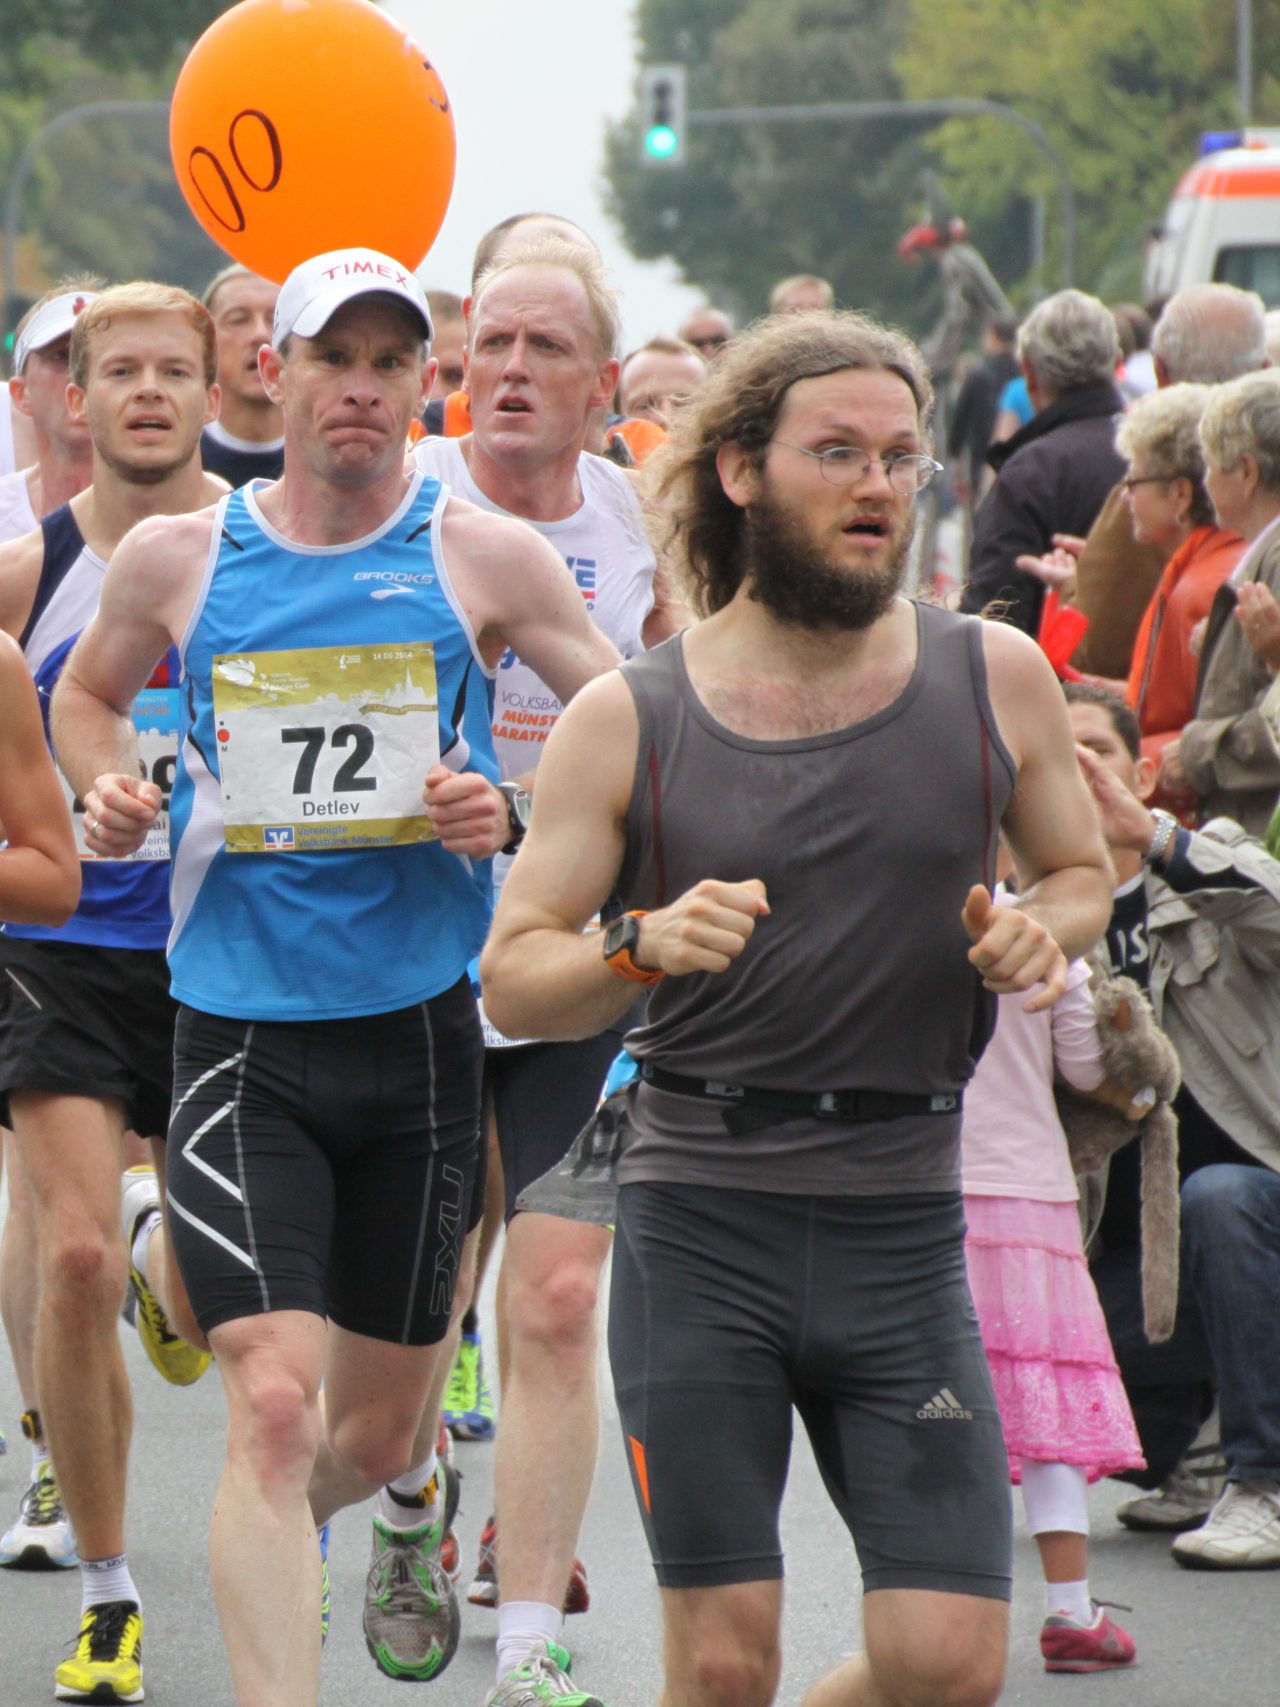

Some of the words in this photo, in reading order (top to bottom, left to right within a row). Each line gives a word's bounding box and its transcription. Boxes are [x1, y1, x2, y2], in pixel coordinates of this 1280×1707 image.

[321, 260, 409, 289] TIMEX
[353, 571, 434, 585] BROOKS
[501, 690, 564, 711] VOLKSBA
[280, 723, 378, 795] 72
[302, 800, 361, 817] Detlev
[915, 1408, 974, 1421] adidas
